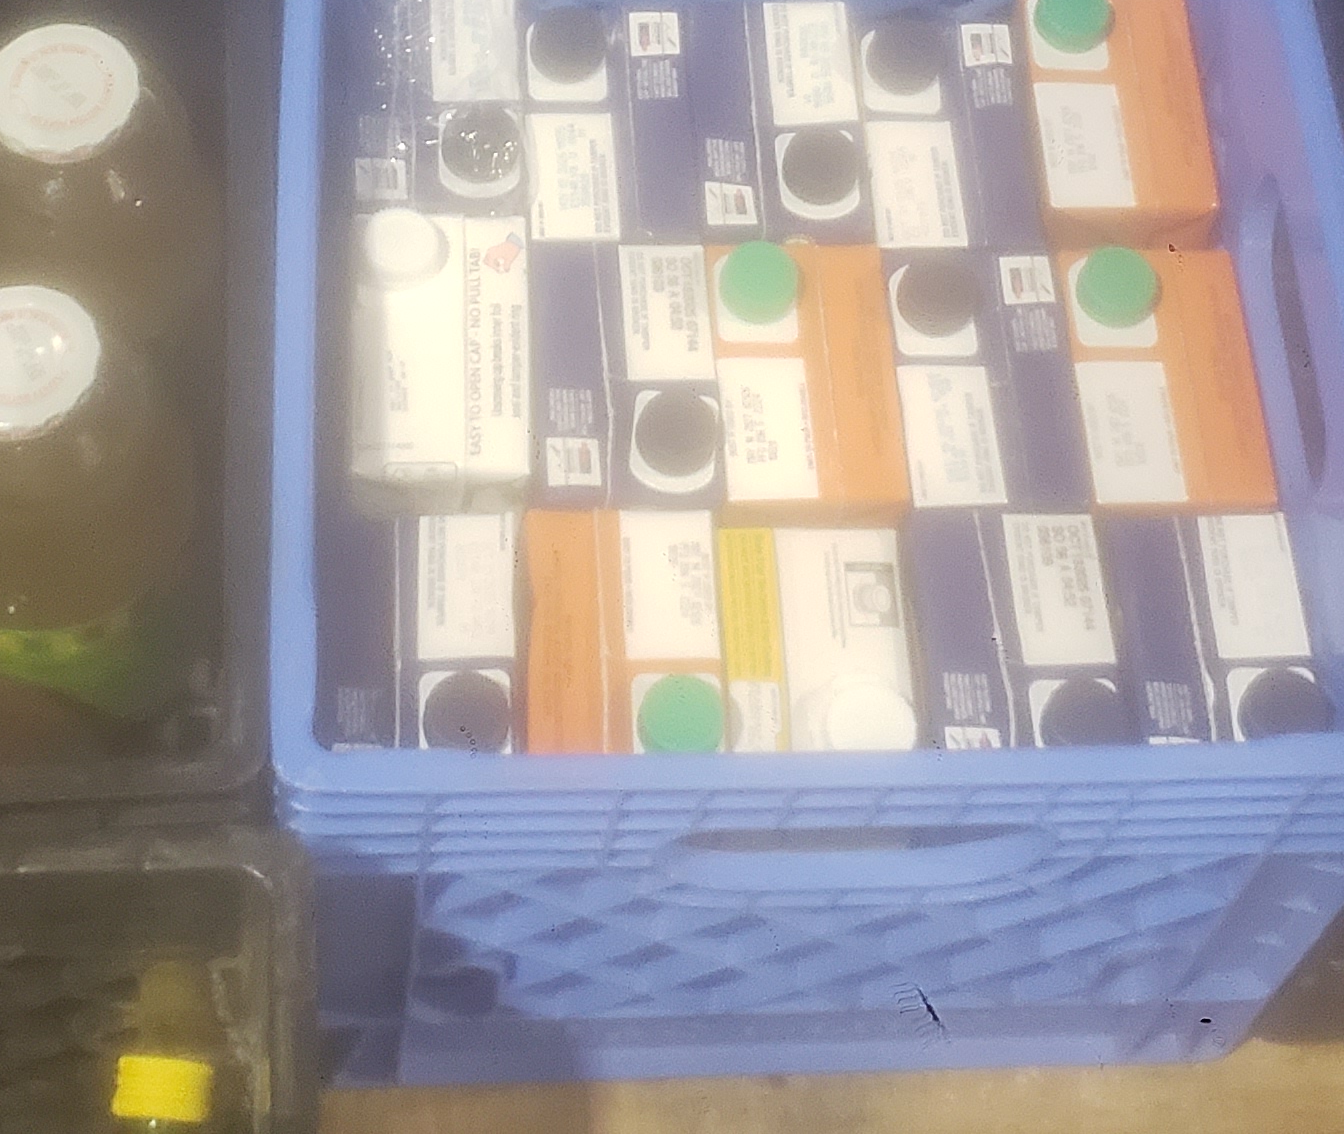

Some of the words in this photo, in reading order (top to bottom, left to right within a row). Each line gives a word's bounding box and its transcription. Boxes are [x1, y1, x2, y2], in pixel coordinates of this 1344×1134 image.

[469, 276, 481, 305] PULL
[469, 308, 481, 329] NO
[469, 340, 481, 364] CAP
[470, 367, 481, 402] OPEN
[470, 425, 482, 456] EASY
